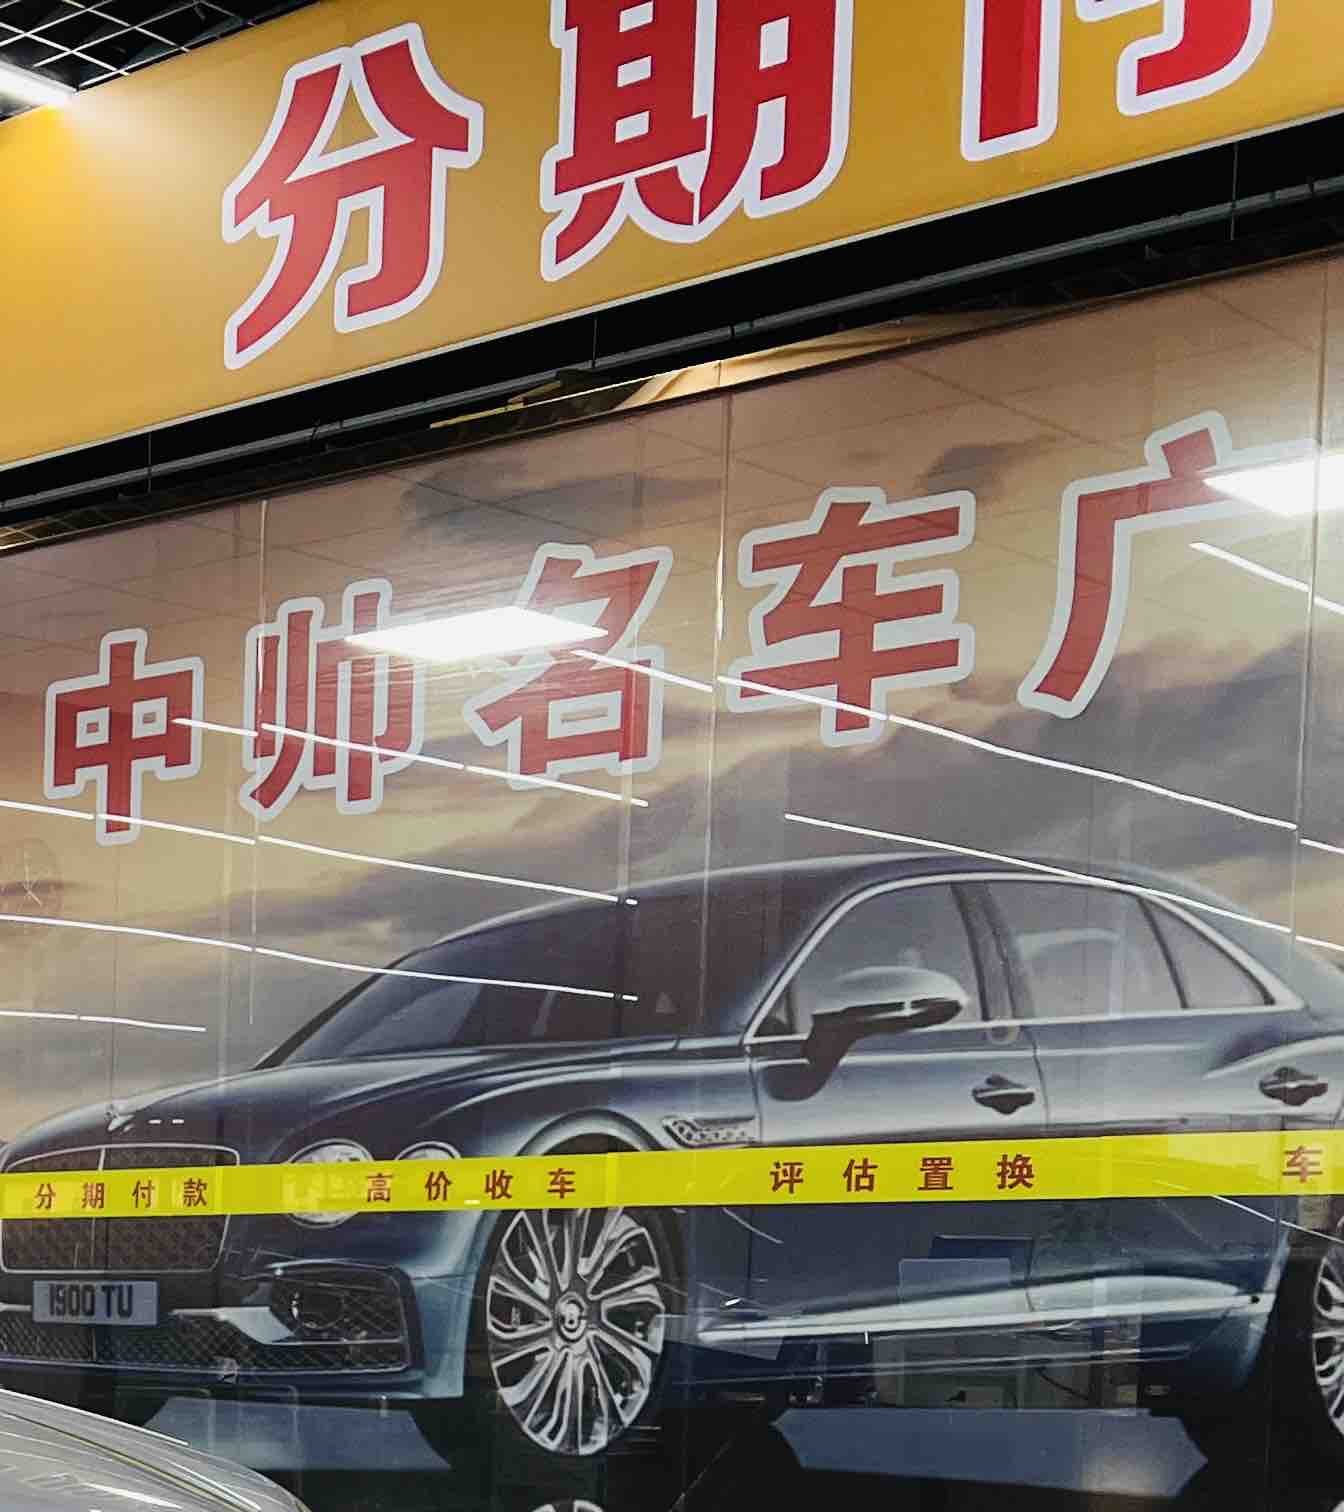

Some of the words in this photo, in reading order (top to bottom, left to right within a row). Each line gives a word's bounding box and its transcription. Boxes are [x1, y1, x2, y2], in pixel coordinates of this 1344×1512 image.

[769, 1152, 1036, 1193] 评估置换
[1281, 1145, 1324, 1184] 车
[33, 1177, 209, 1211] 分期付款
[365, 1168, 577, 1203] 高价收车
